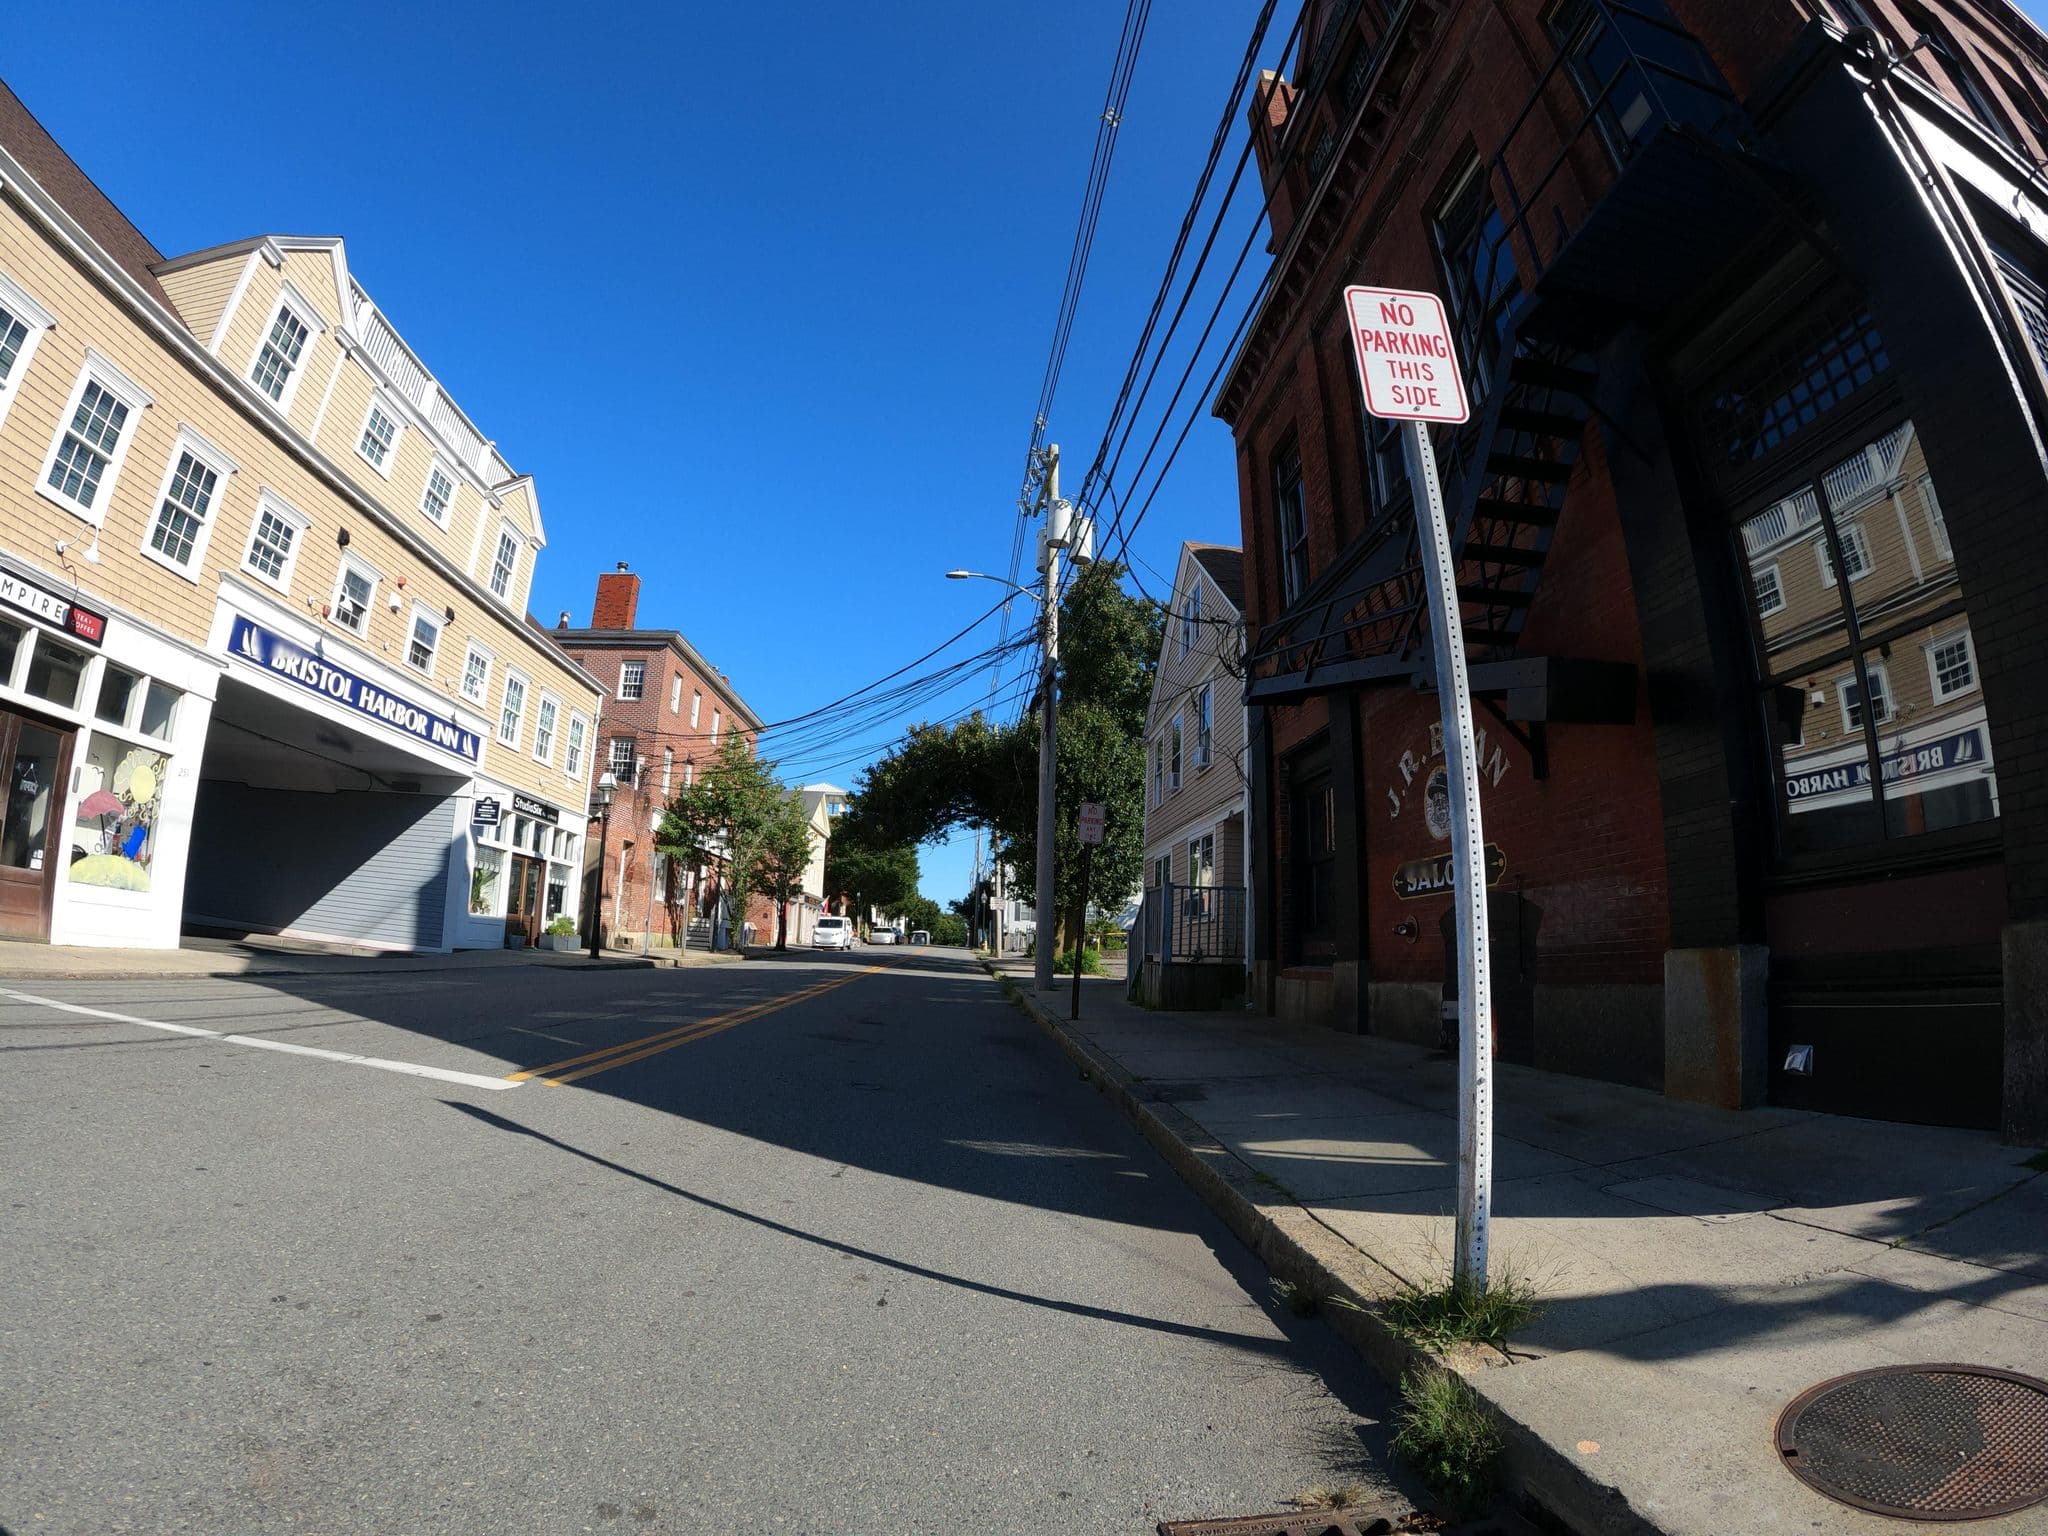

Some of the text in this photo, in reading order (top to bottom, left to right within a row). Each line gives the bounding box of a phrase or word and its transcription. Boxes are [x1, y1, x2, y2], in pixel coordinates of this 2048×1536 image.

[1379, 302, 1415, 326] NO
[1361, 329, 1448, 359] PARKING
[1386, 360, 1435, 382] THIS
[1391, 385, 1442, 407] SIDE
[1, 578, 63, 619] MPIRE
[70, 619, 95, 635] COFFEE
[77, 613, 88, 623] TEA
[271, 644, 460, 750] BRISTOL HARBOR INN
